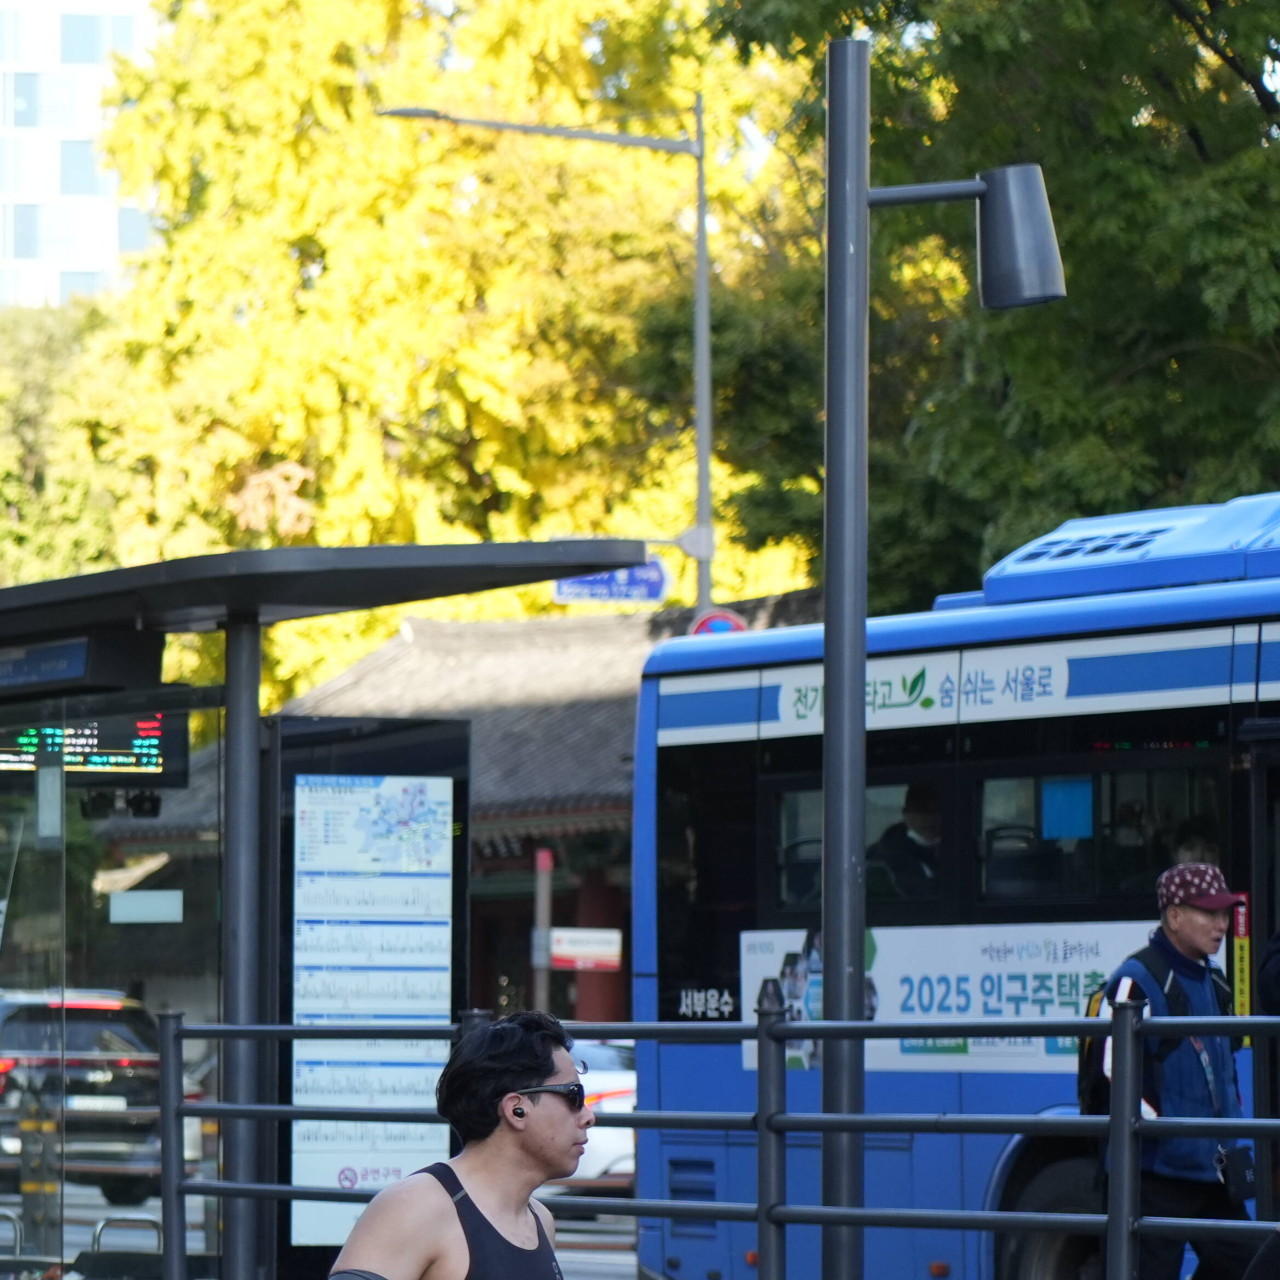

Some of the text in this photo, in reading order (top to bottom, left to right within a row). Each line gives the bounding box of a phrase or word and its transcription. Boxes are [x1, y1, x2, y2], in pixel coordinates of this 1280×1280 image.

[1002, 665, 1053, 703] 서울로
[679, 989, 733, 1018] 서부운수
[899, 975, 971, 1013] 2025
